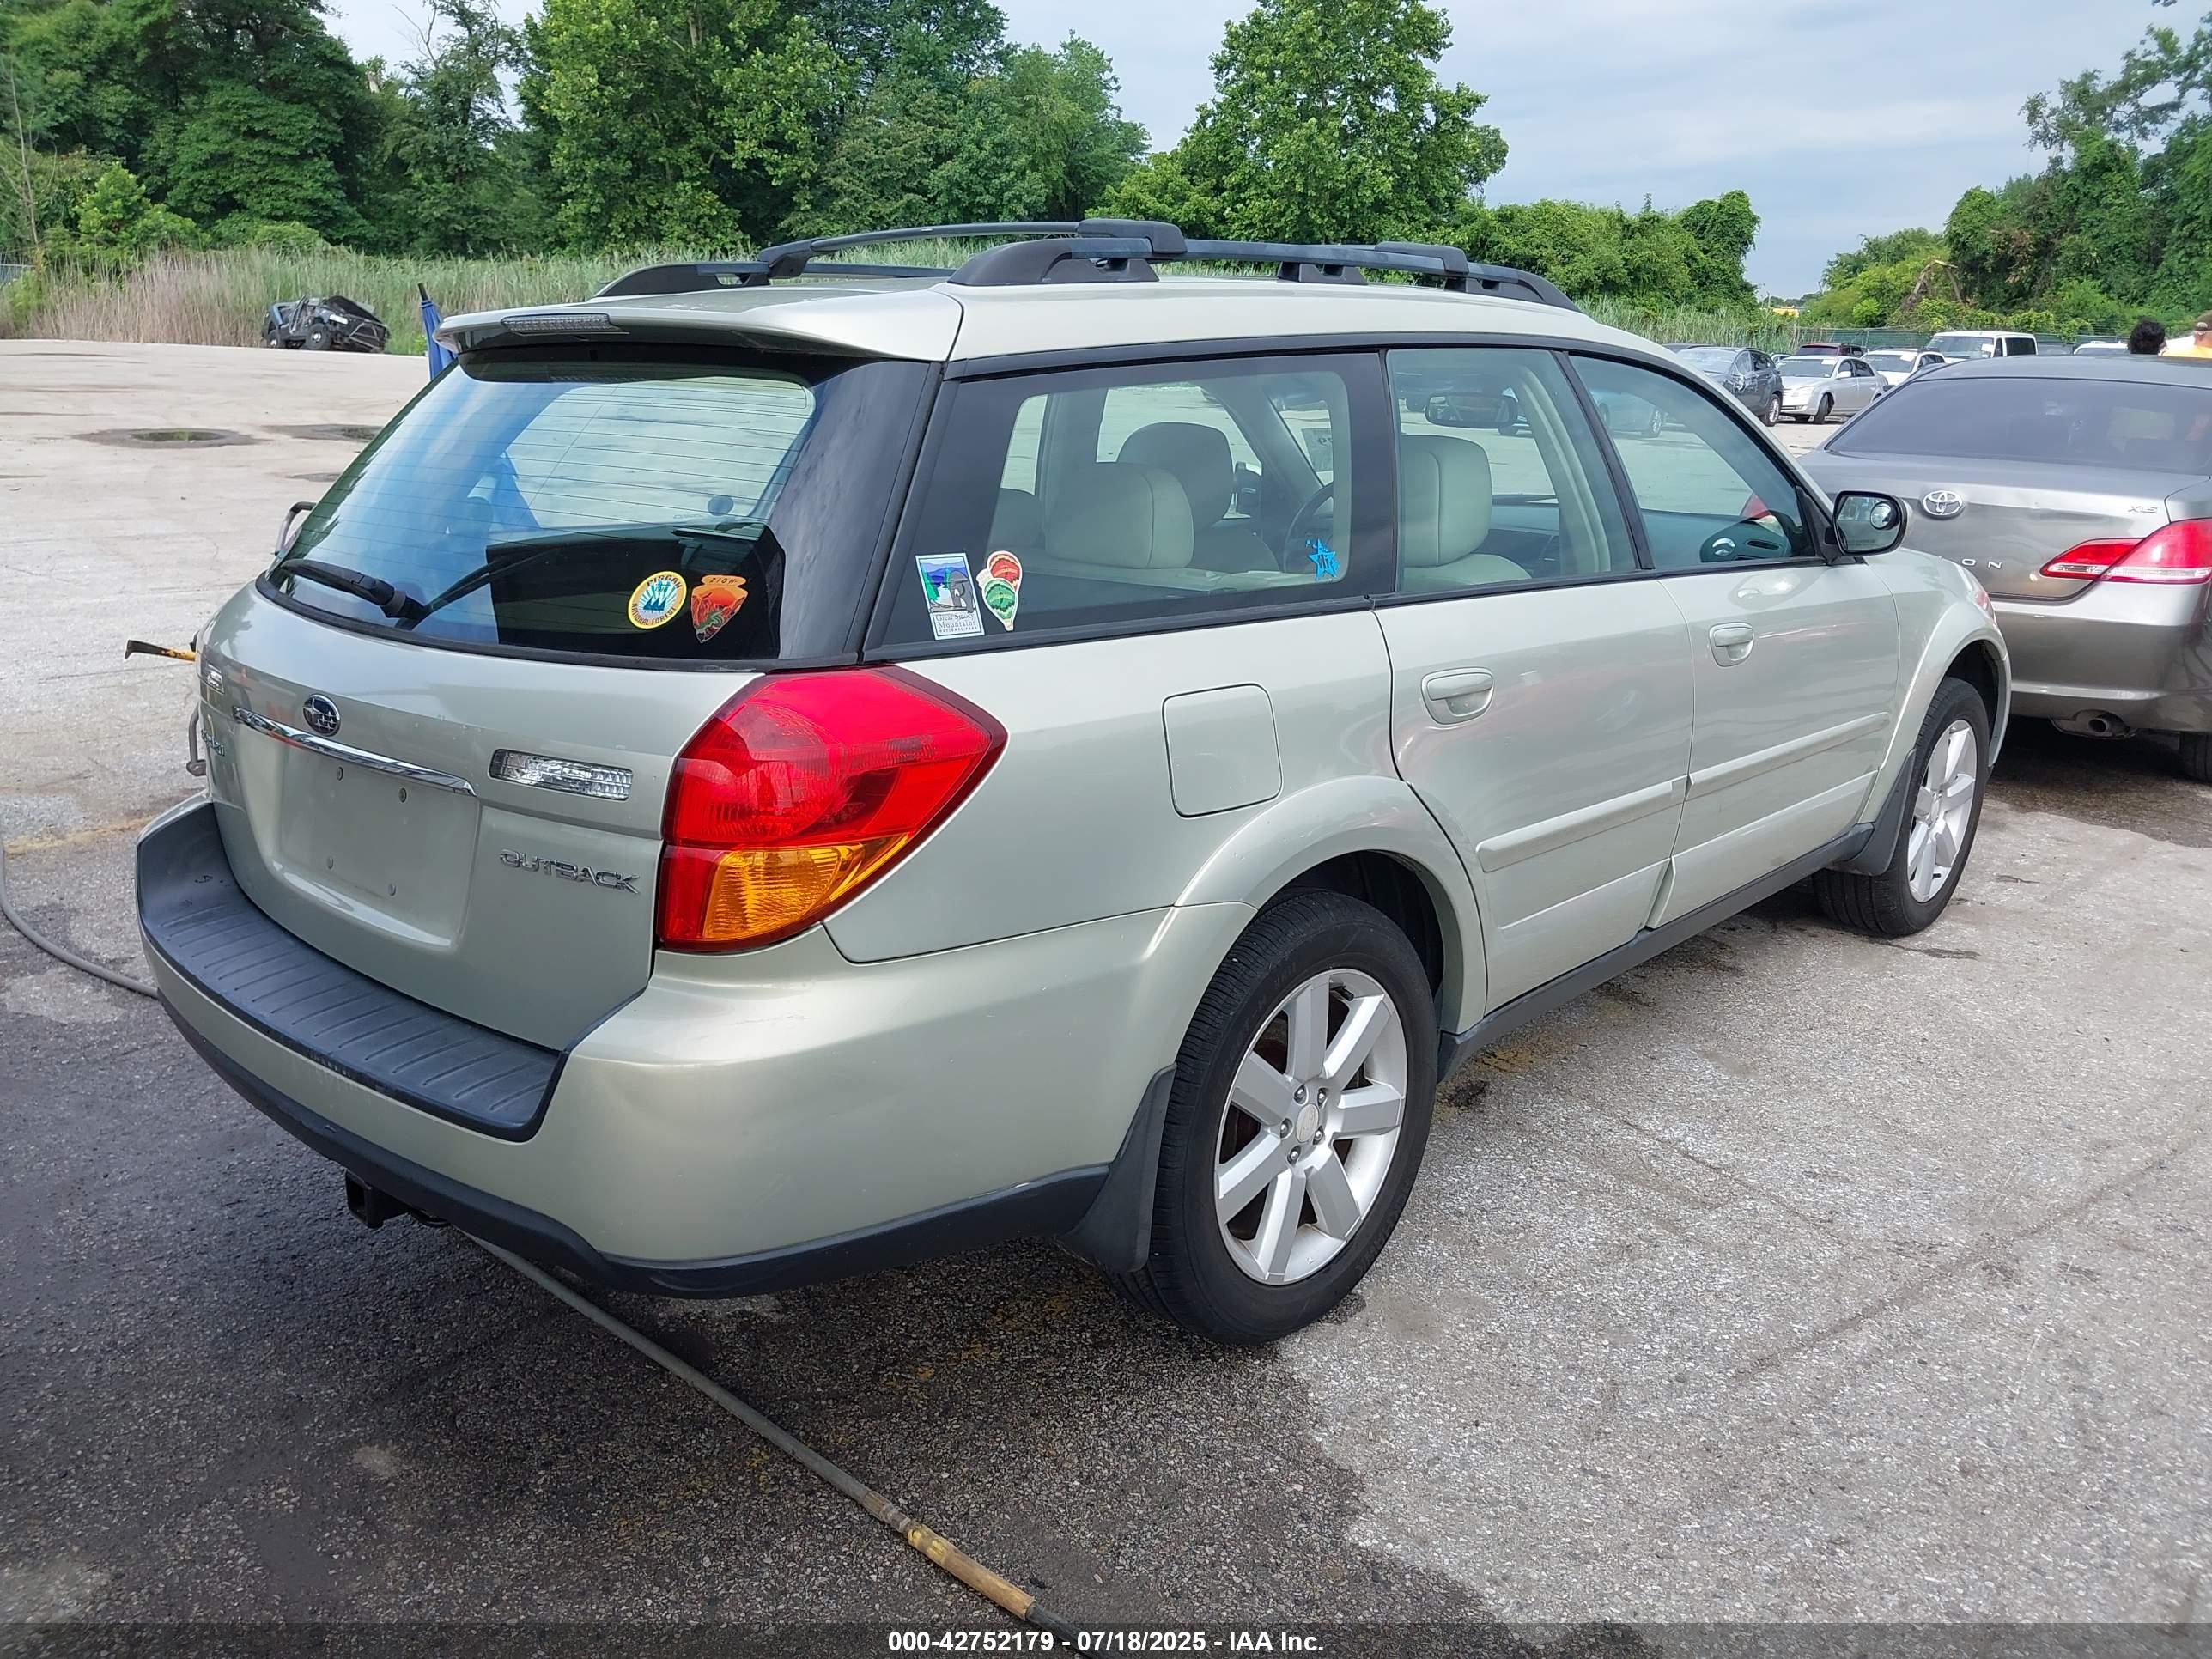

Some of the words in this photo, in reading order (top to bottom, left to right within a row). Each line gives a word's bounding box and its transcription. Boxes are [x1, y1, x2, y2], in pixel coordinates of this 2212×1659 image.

[646, 574, 683, 589] PISGAH
[631, 603, 649, 625] NATIONAL
[650, 606, 677, 626] FOREST
[500, 848, 641, 894] OUTBACK
